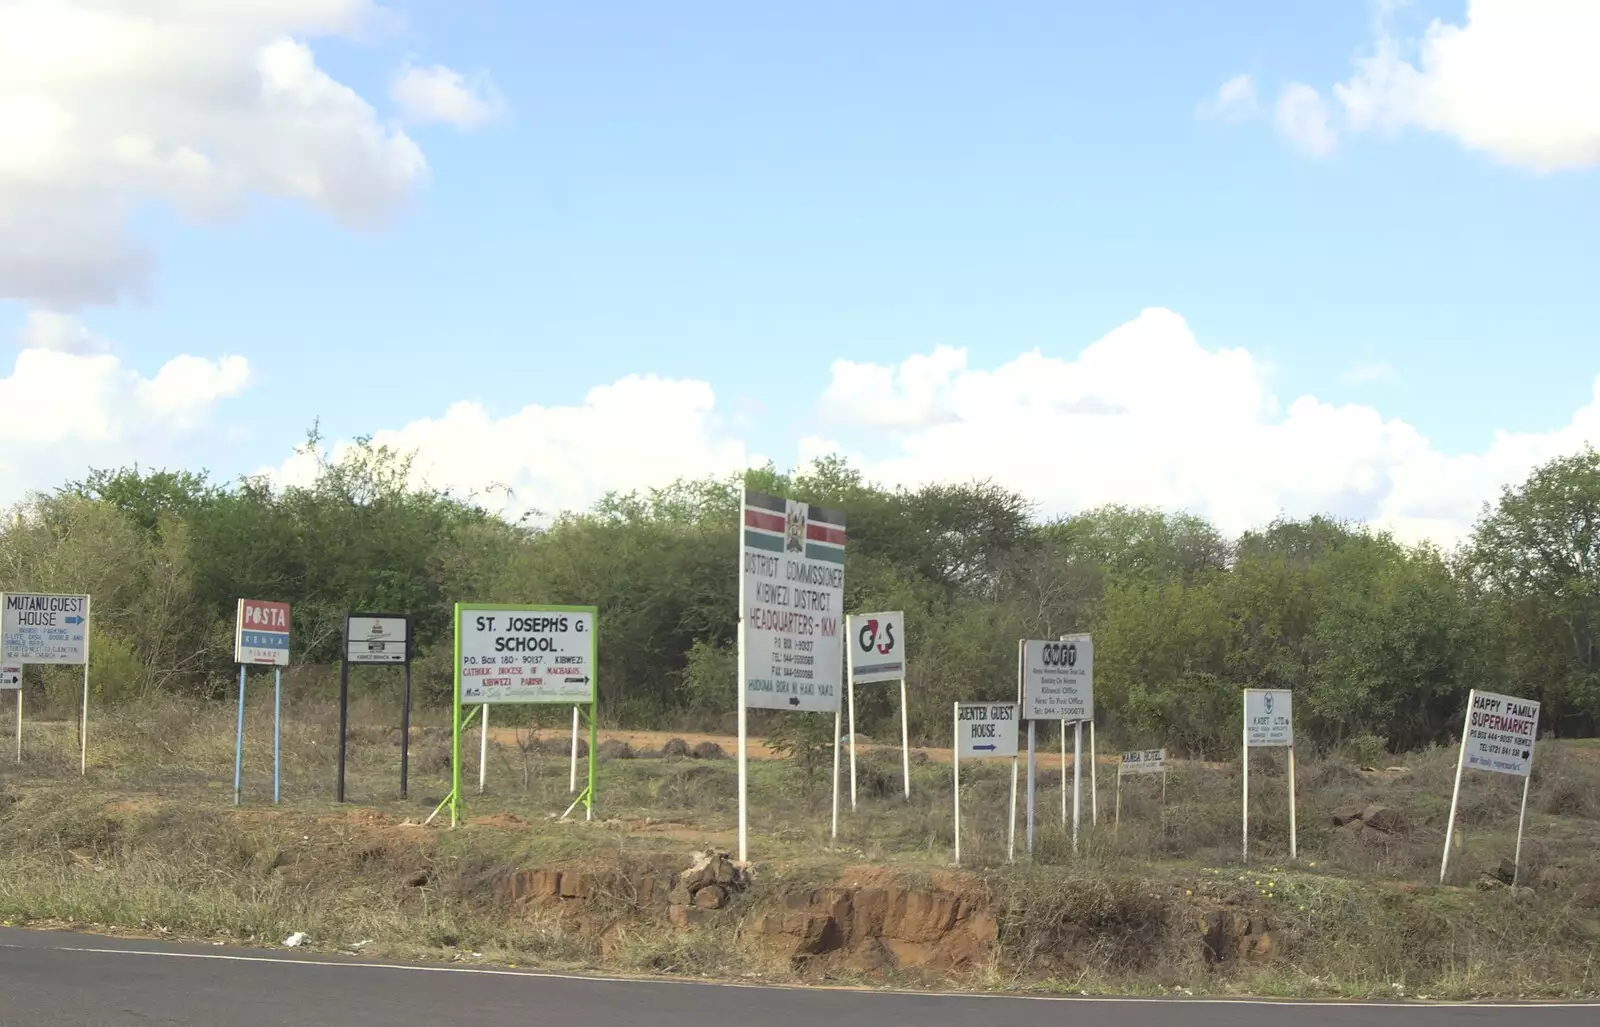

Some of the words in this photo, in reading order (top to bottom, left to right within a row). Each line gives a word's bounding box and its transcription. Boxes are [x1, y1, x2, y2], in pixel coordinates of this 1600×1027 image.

[744, 552, 780, 578] DISTRICT
[786, 560, 842, 588] COMMISSIONER
[757, 582, 790, 605] KIBWEZI
[7, 596, 48, 611] MUTANU
[50, 598, 84, 612] GUEST
[18, 612, 56, 626] HOUSE
[246, 606, 285, 626] POSTA
[476, 616, 496, 632] ST.
[575, 620, 588, 632] G.
[245, 636, 283, 644] KENYA
[495, 637, 564, 652] SCHOOL.
[859, 619, 894, 655] G4S
[464, 656, 478, 665] P.O.
[1043, 644, 1077, 667] KWFT
[463, 667, 492, 676] CATHOLIC
[498, 666, 523, 675] DIOCESE
[482, 678, 511, 686] KIBWEZI
[776, 680, 789, 693] BORA
[991, 706, 1014, 720] GUEST
[1473, 696, 1501, 712] HAPPY
[1506, 703, 1537, 718] FAMILY
[1472, 712, 1535, 736] SUPERMARKET
